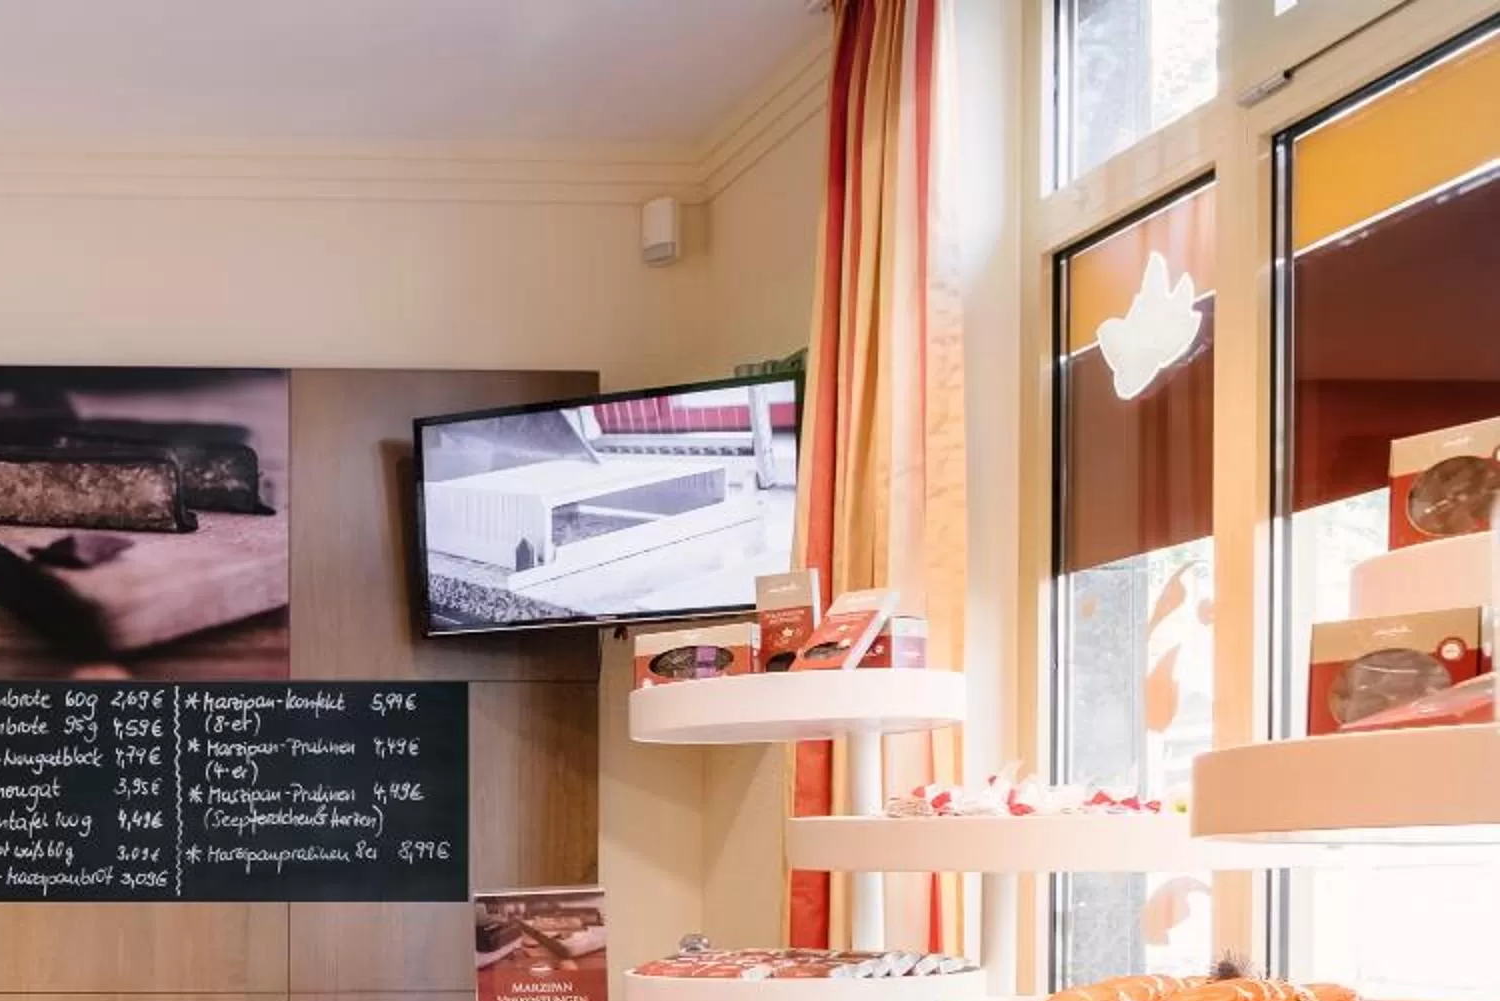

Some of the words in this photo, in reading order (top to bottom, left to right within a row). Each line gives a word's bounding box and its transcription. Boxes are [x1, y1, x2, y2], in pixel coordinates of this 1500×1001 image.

[110, 689, 165, 712] 2,69€
[370, 692, 418, 719] 5,99€
[397, 840, 451, 866] 8,99€
